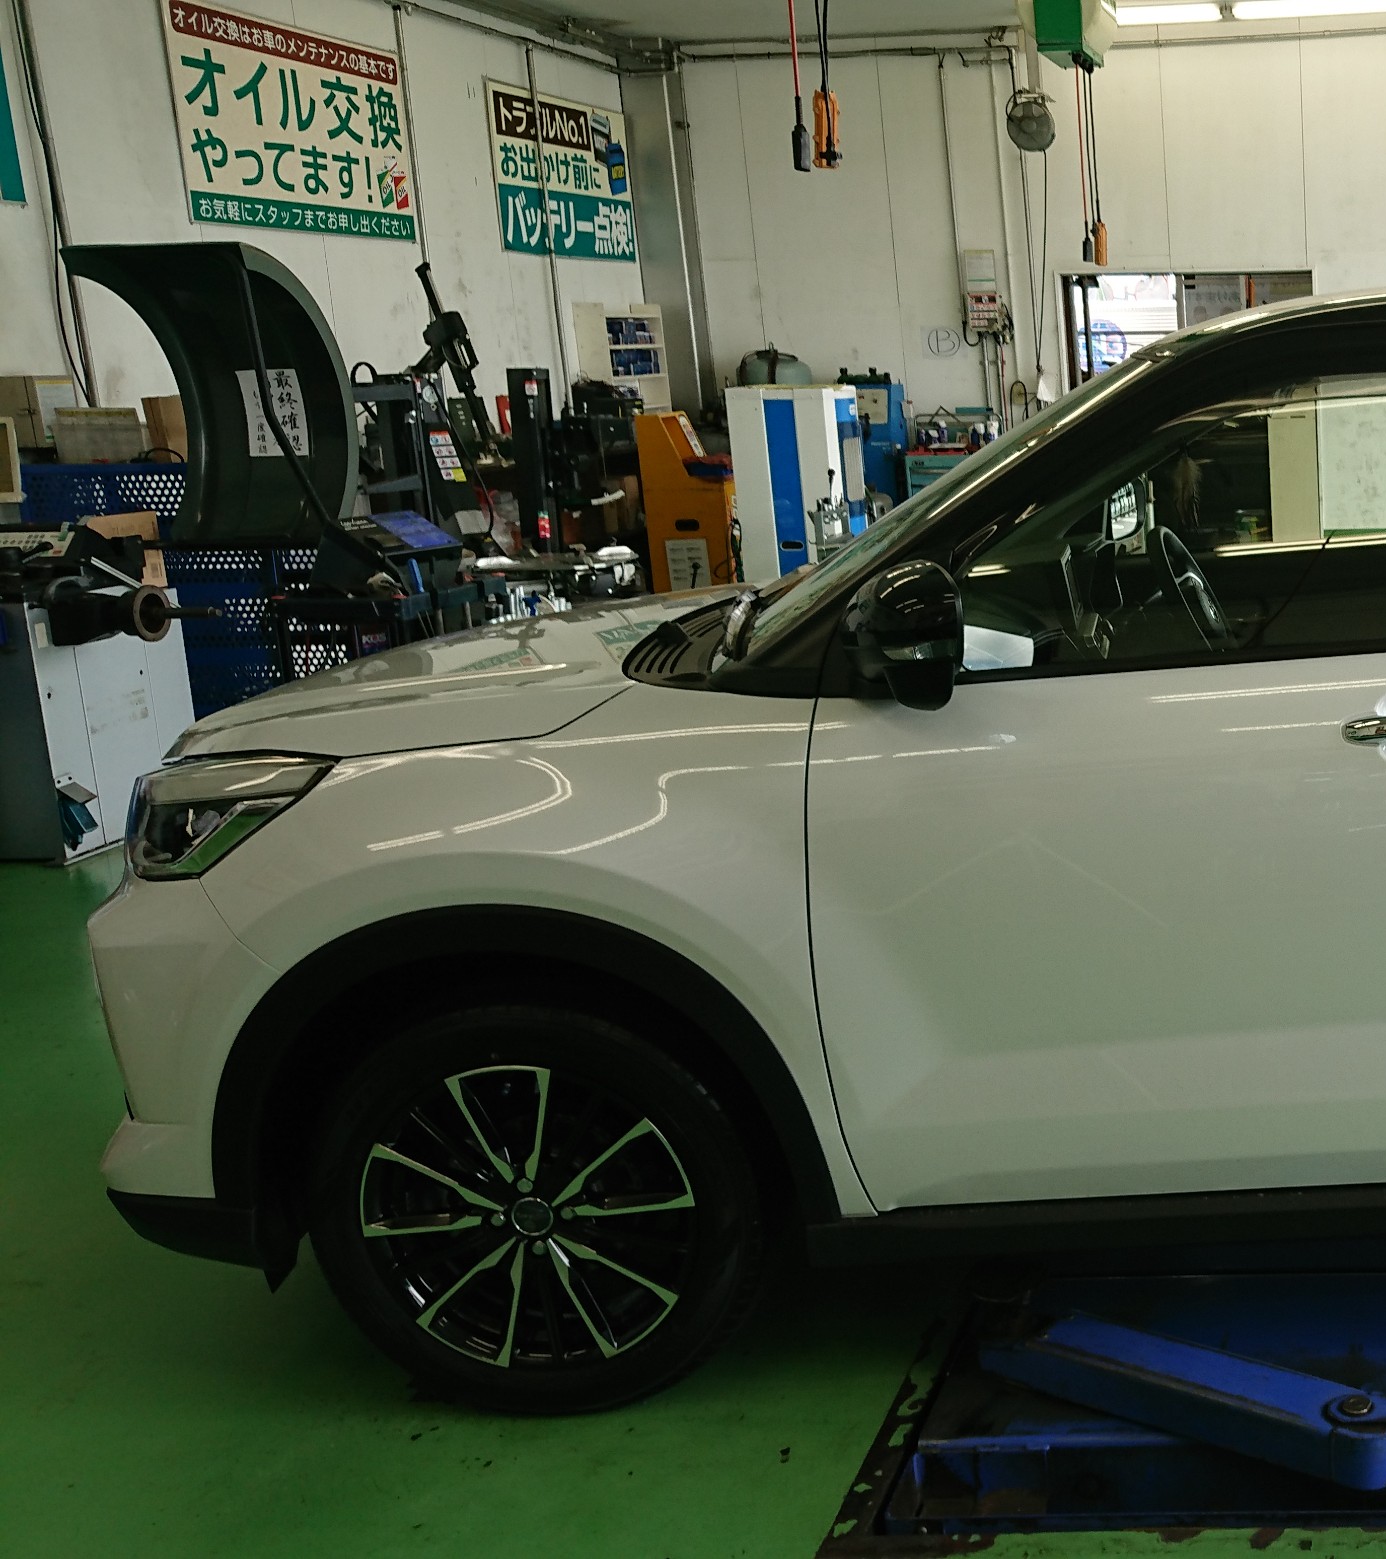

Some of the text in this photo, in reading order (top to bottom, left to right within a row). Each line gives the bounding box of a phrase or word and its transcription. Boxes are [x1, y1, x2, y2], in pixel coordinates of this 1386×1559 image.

[173, 6, 395, 80] オイル交換はお車のメンテナンスの基本です
[180, 47, 403, 152] オイル交換
[190, 127, 374, 204] やってます!
[199, 198, 411, 236] お気軽にスタッフまでお申し出ください
